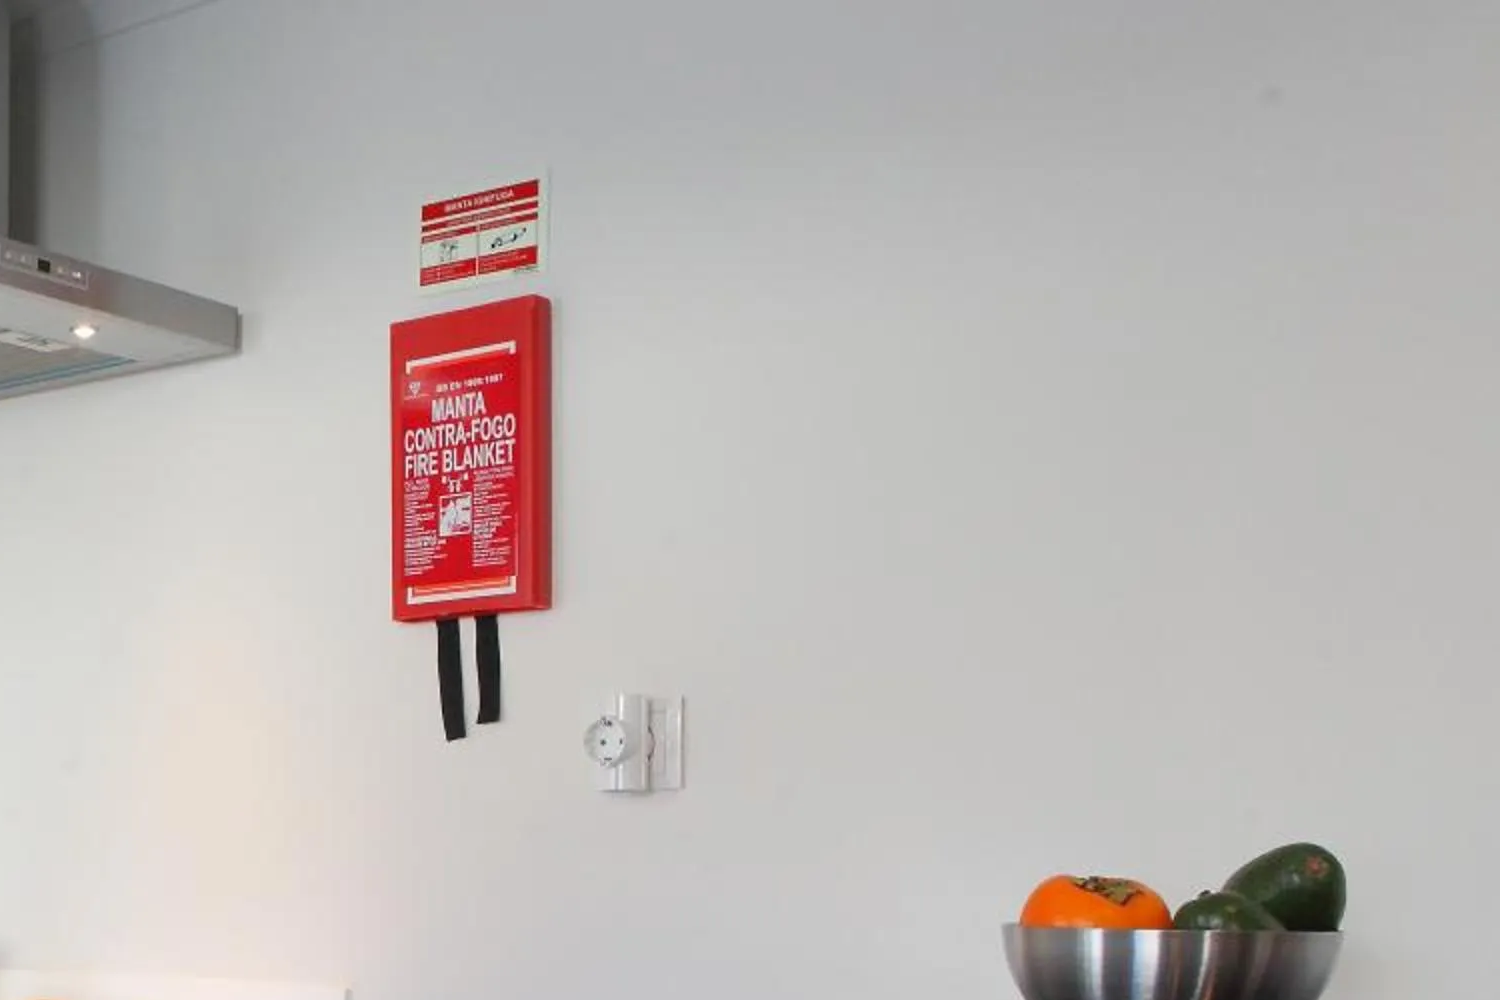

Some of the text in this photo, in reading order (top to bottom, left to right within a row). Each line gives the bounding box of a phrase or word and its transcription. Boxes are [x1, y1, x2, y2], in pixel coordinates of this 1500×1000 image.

[431, 390, 487, 422] MANTA
[404, 413, 516, 453] CONTRA-FOGO
[405, 438, 516, 479] FIRE BLANKET
